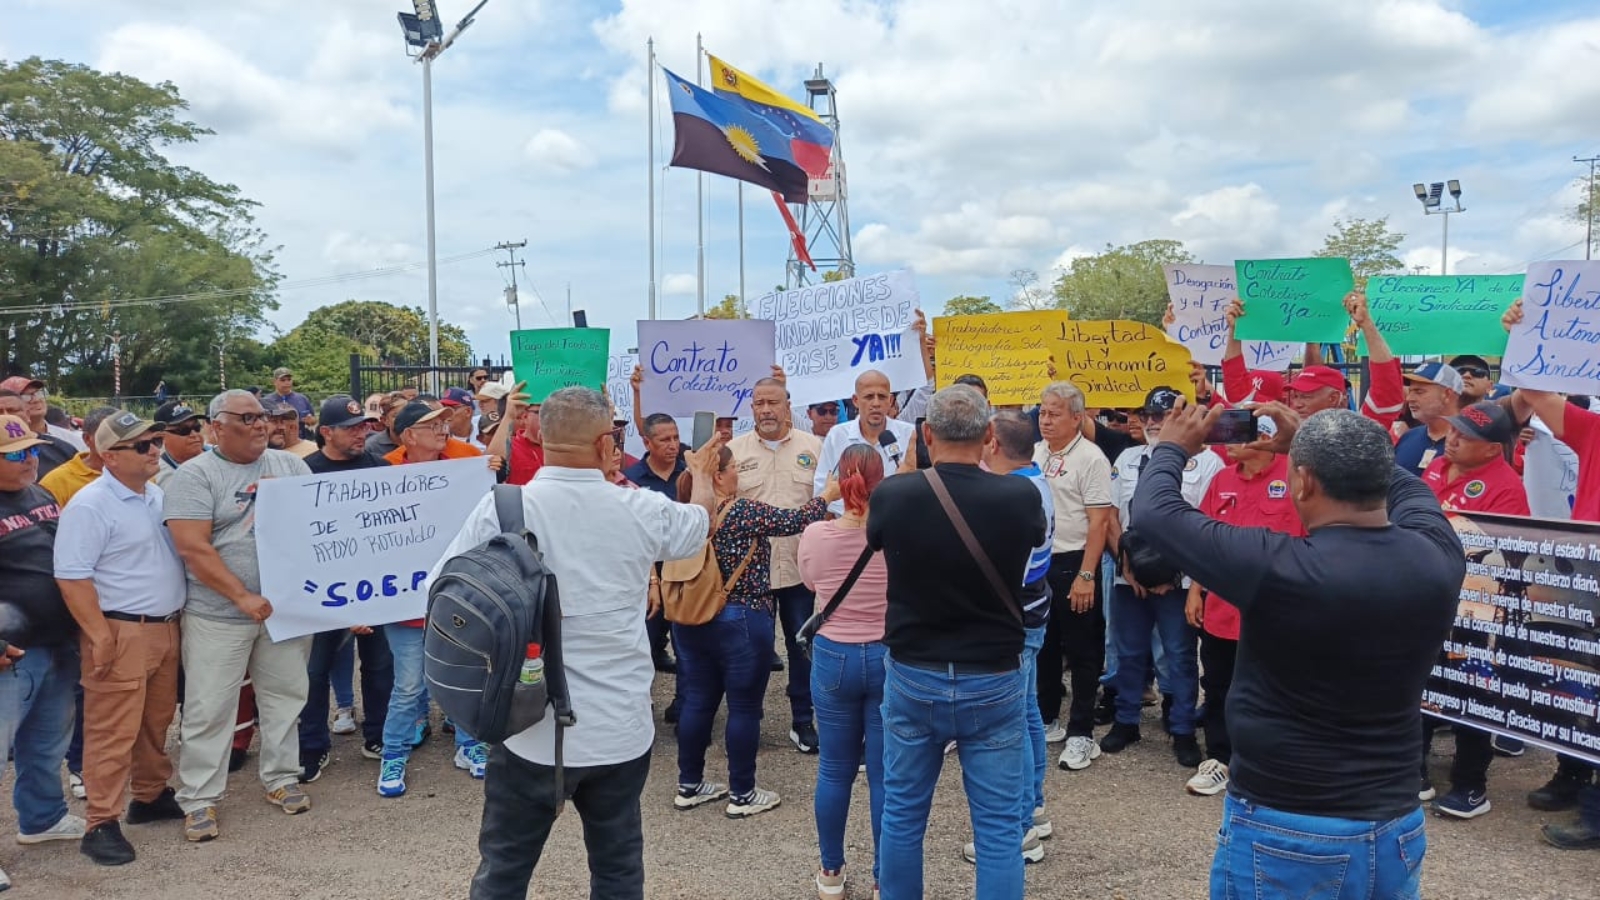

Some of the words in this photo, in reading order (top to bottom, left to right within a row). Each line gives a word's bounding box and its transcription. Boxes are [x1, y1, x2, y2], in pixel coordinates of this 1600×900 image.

[758, 275, 892, 322] ELECCIONES
[1056, 321, 1153, 345] Libertad
[1178, 315, 1230, 342] Contrat
[651, 339, 738, 375] Contrato
[781, 345, 840, 377] BASE
[1066, 349, 1167, 372] Autonomía
[668, 374, 742, 394] Colectivo
[309, 519, 339, 537] DE
[354, 503, 421, 530] BARALT
[311, 535, 359, 564] APOYO
[1497, 535, 1538, 554] petroleros
[1540, 539, 1555, 556] del
[1555, 543, 1586, 560] estado
[1466, 561, 1488, 577] ujeres
[1522, 570, 1532, 583] su
[1534, 569, 1570, 589] esfuerzo
[1482, 588, 1490, 605] la
[1521, 595, 1533, 613] de
[1534, 600, 1566, 619] nuestra
[1504, 621, 1516, 638] de
[1529, 631, 1566, 650] nuestras
[1453, 642, 1463, 654] un
[1464, 642, 1494, 664] ejemplo
[1495, 648, 1507, 666] de
[1508, 655, 1555, 677] constancia
[1556, 664, 1563, 682] y
[1443, 667, 1468, 685] manos
[1469, 673, 1475, 686] a
[1475, 672, 1488, 690] las
[1488, 676, 1501, 693] del
[1502, 680, 1530, 702] pueblo
[1531, 688, 1551, 706] para
[1552, 691, 1597, 718] constituir
[1428, 690, 1460, 710] progreso
[1461, 699, 1467, 716] y
[1542, 722, 1557, 739] por
[1558, 727, 1570, 742] su
